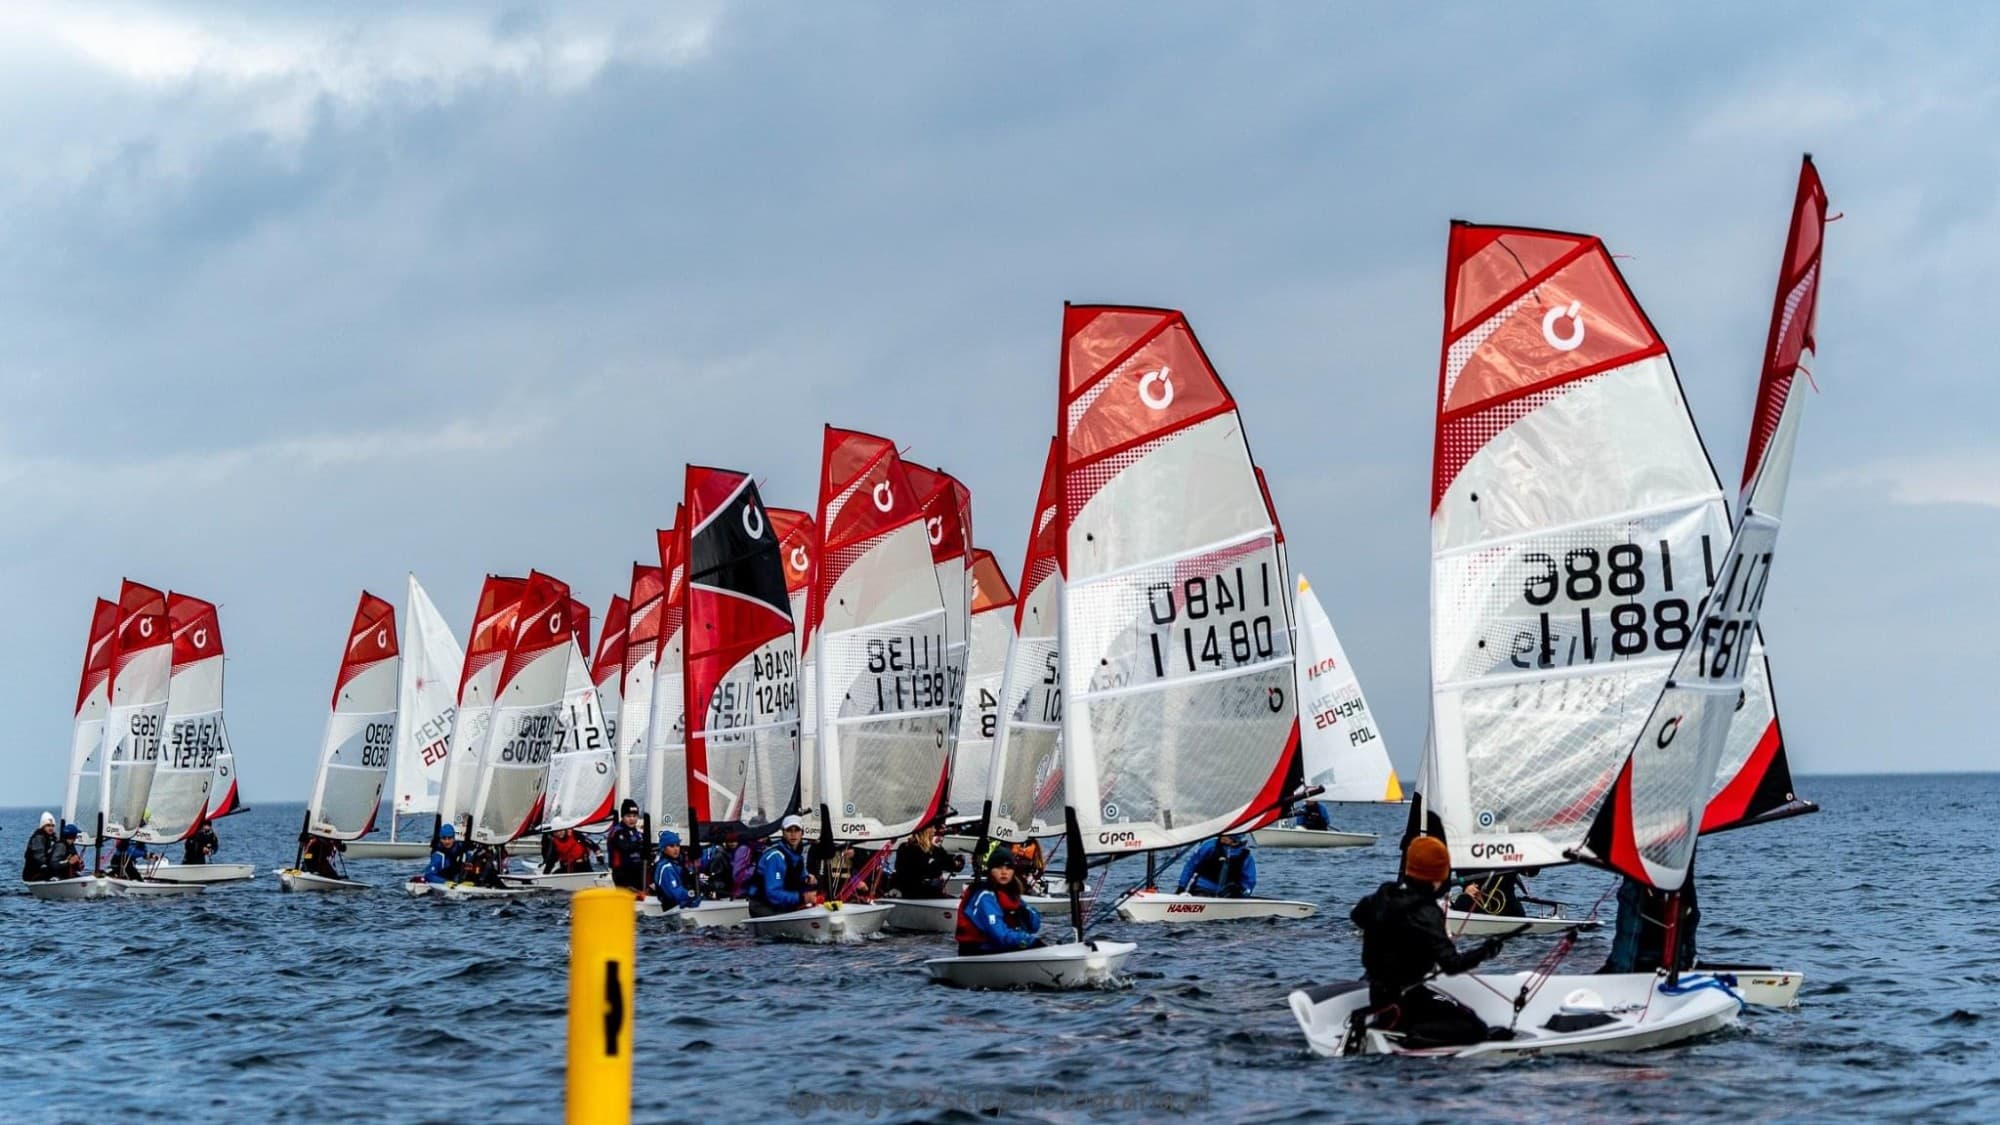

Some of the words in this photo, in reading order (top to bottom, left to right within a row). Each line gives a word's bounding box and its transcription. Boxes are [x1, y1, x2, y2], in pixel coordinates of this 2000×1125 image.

[1150, 615, 1273, 678] 11480
[1308, 658, 1335, 680] ILCA
[755, 681, 795, 715] 12464
[877, 672, 944, 712] 11138
[1314, 697, 1364, 730] 204341
[1350, 727, 1376, 747] POL
[1099, 831, 1134, 845] Open
[1472, 842, 1515, 859] Open
[1167, 904, 1206, 913] HARKEN
